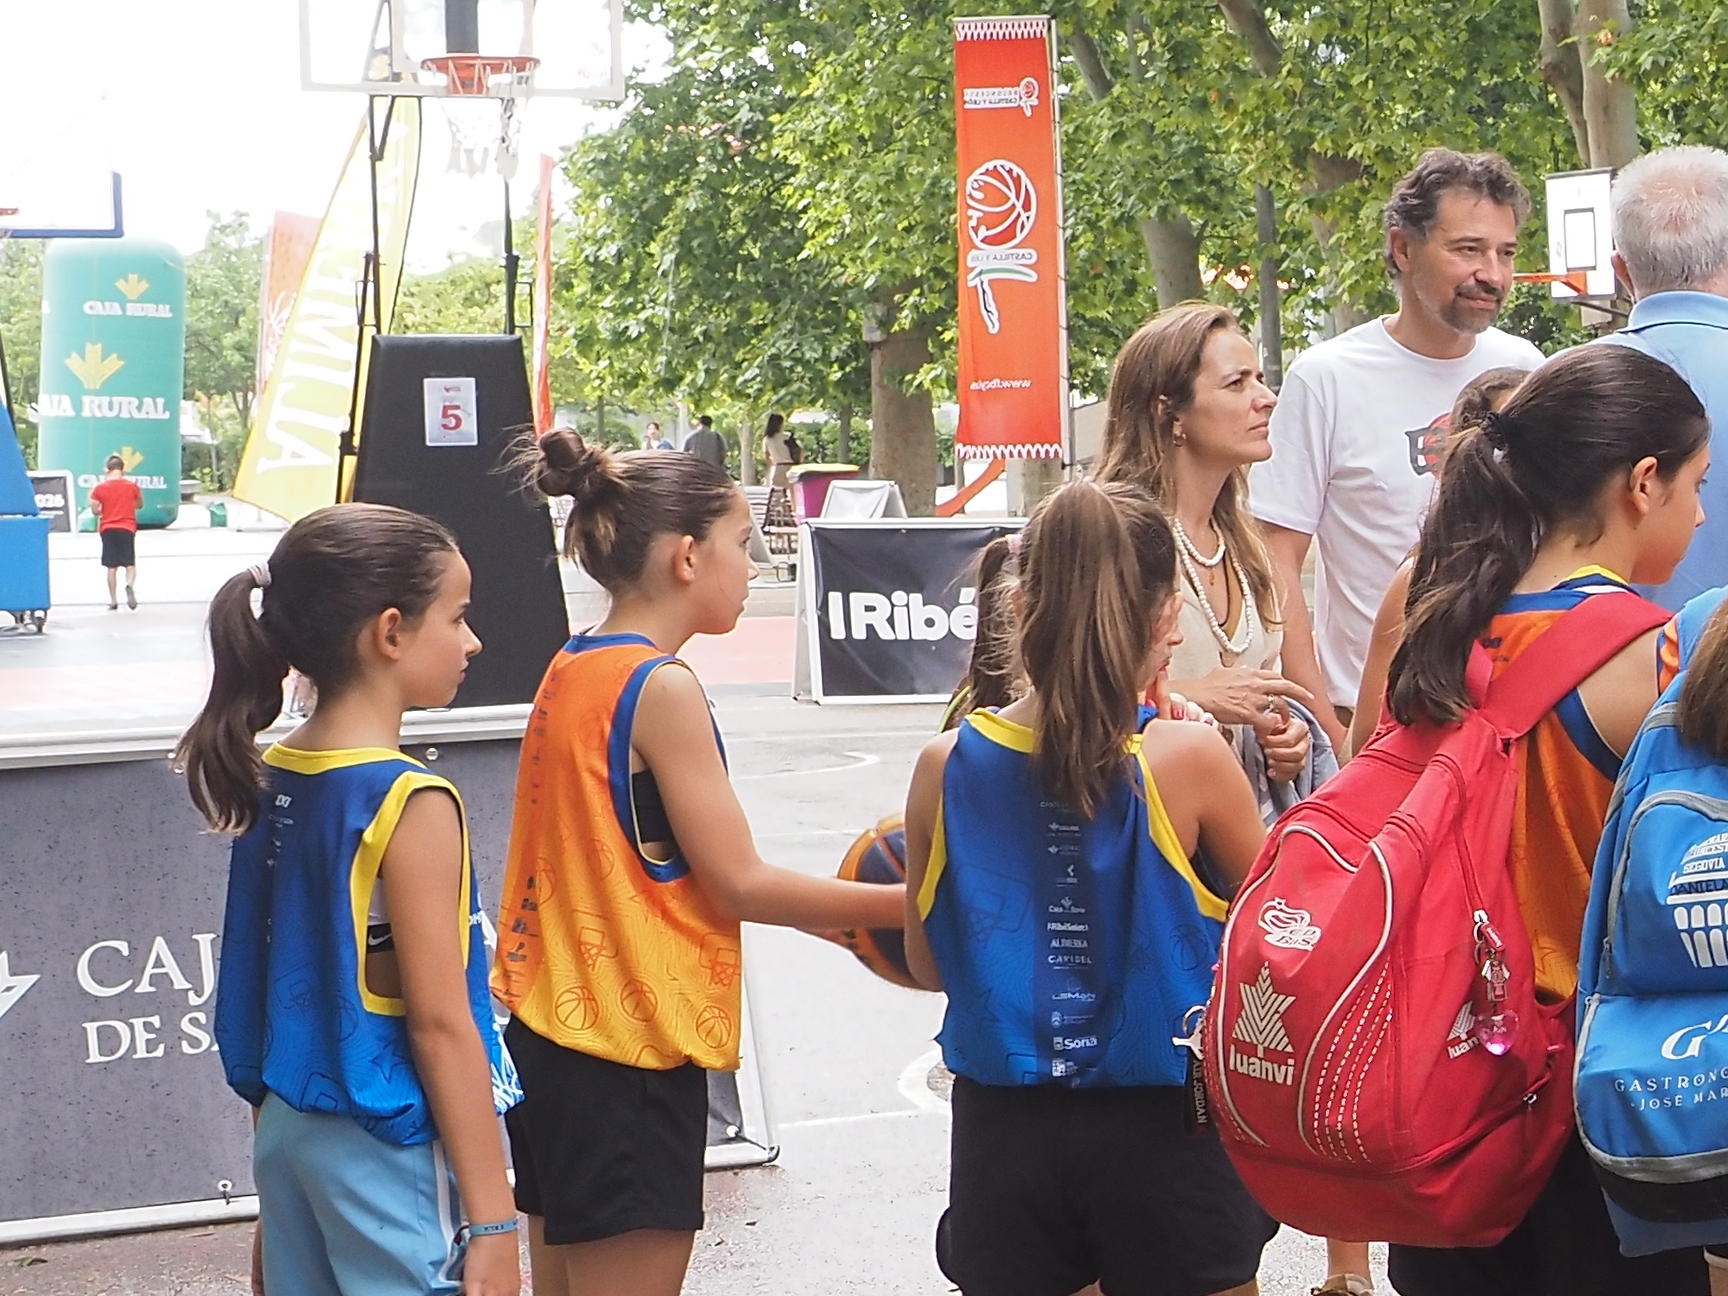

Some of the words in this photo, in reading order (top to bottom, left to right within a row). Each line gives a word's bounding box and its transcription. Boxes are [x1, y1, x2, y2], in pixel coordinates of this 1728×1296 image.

[81, 396, 170, 419] RURAL
[441, 405, 462, 431] 5
[77, 932, 220, 1006] CAJ
[82, 1014, 165, 1064] DE
[180, 1011, 220, 1055] S
[1446, 1035, 1480, 1060] luan
[1229, 1043, 1295, 1086] luanvi
[1193, 1080, 1208, 1124] JORDAN
